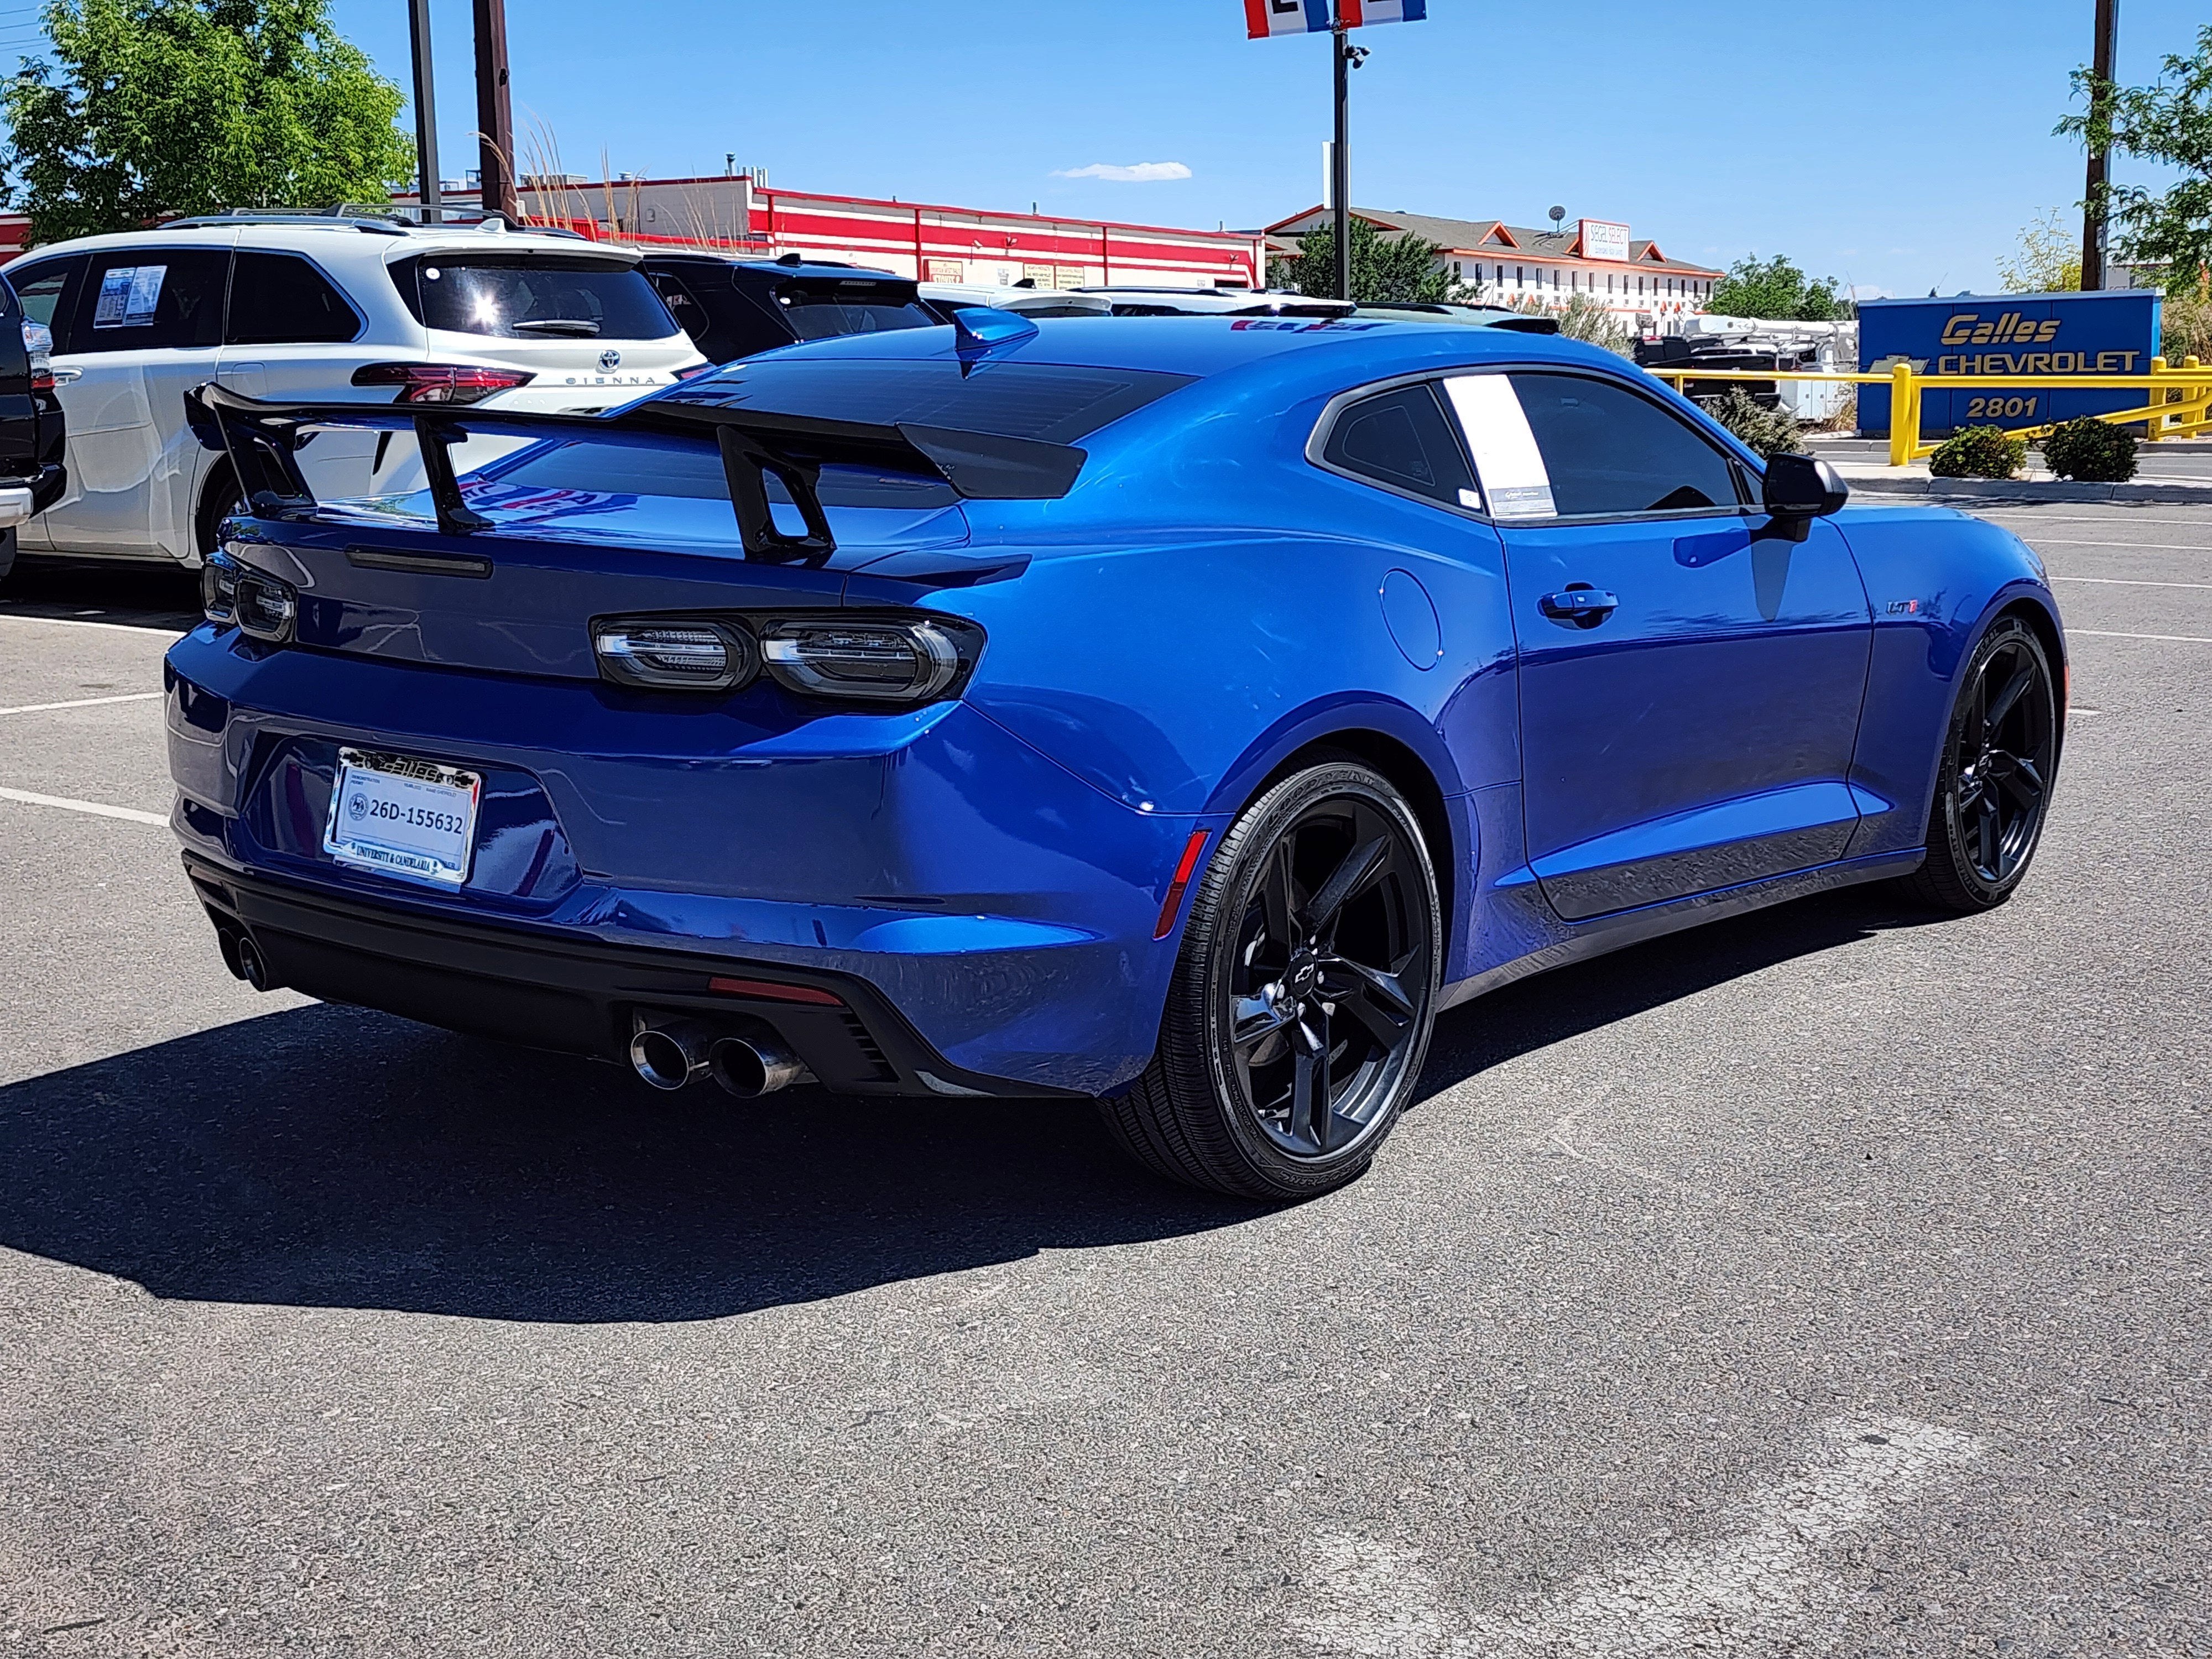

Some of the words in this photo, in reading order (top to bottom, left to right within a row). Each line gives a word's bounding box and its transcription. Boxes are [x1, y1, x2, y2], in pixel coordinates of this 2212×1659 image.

[1940, 312, 2061, 345] Galles
[1938, 351, 2140, 374] CHEVROLET
[1966, 397, 2037, 418] 2801
[1268, 770, 1375, 827] GOODYEAR
[370, 799, 463, 835] 26D-155632
[357, 845, 389, 863] UNIVERSITY
[389, 853, 395, 864] &
[395, 854, 430, 872] CANDELARIA
